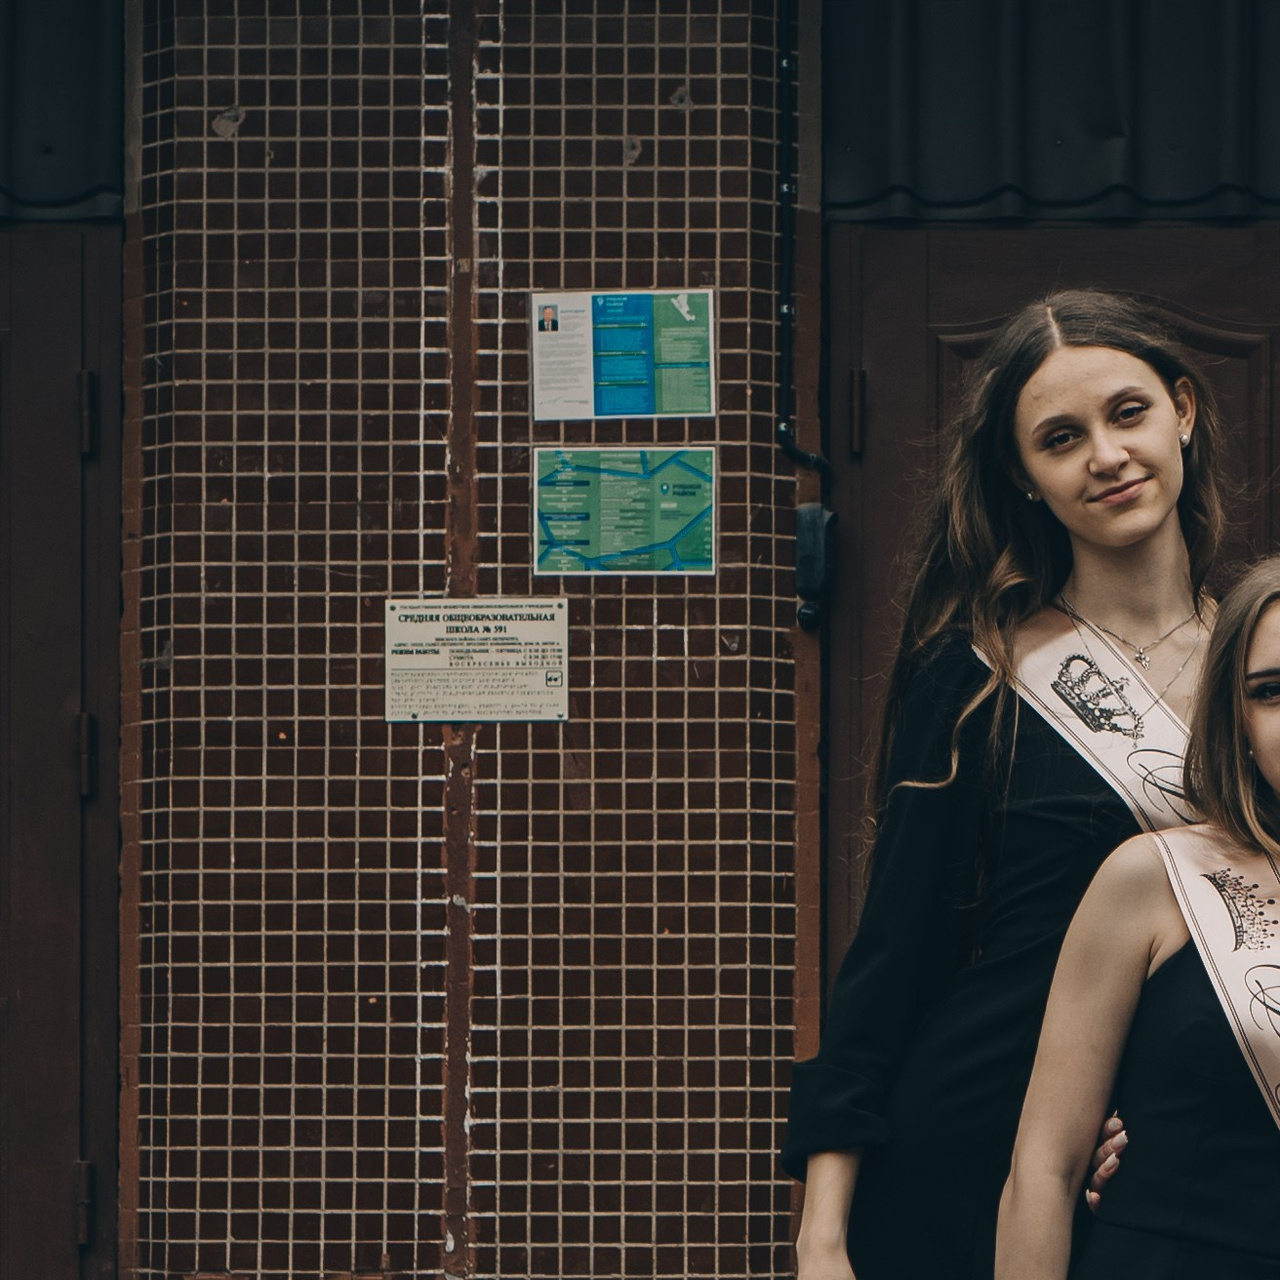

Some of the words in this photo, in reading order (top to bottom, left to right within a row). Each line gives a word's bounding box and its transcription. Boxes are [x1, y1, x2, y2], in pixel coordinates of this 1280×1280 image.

[398, 614, 441, 623] СРЕДНЯЯ
[442, 613, 555, 623] ОБЩЕОБРАЗОВАТЕЛЬНАЯ
[445, 625, 480, 634] ШКОЛА
[494, 625, 507, 633] 591
